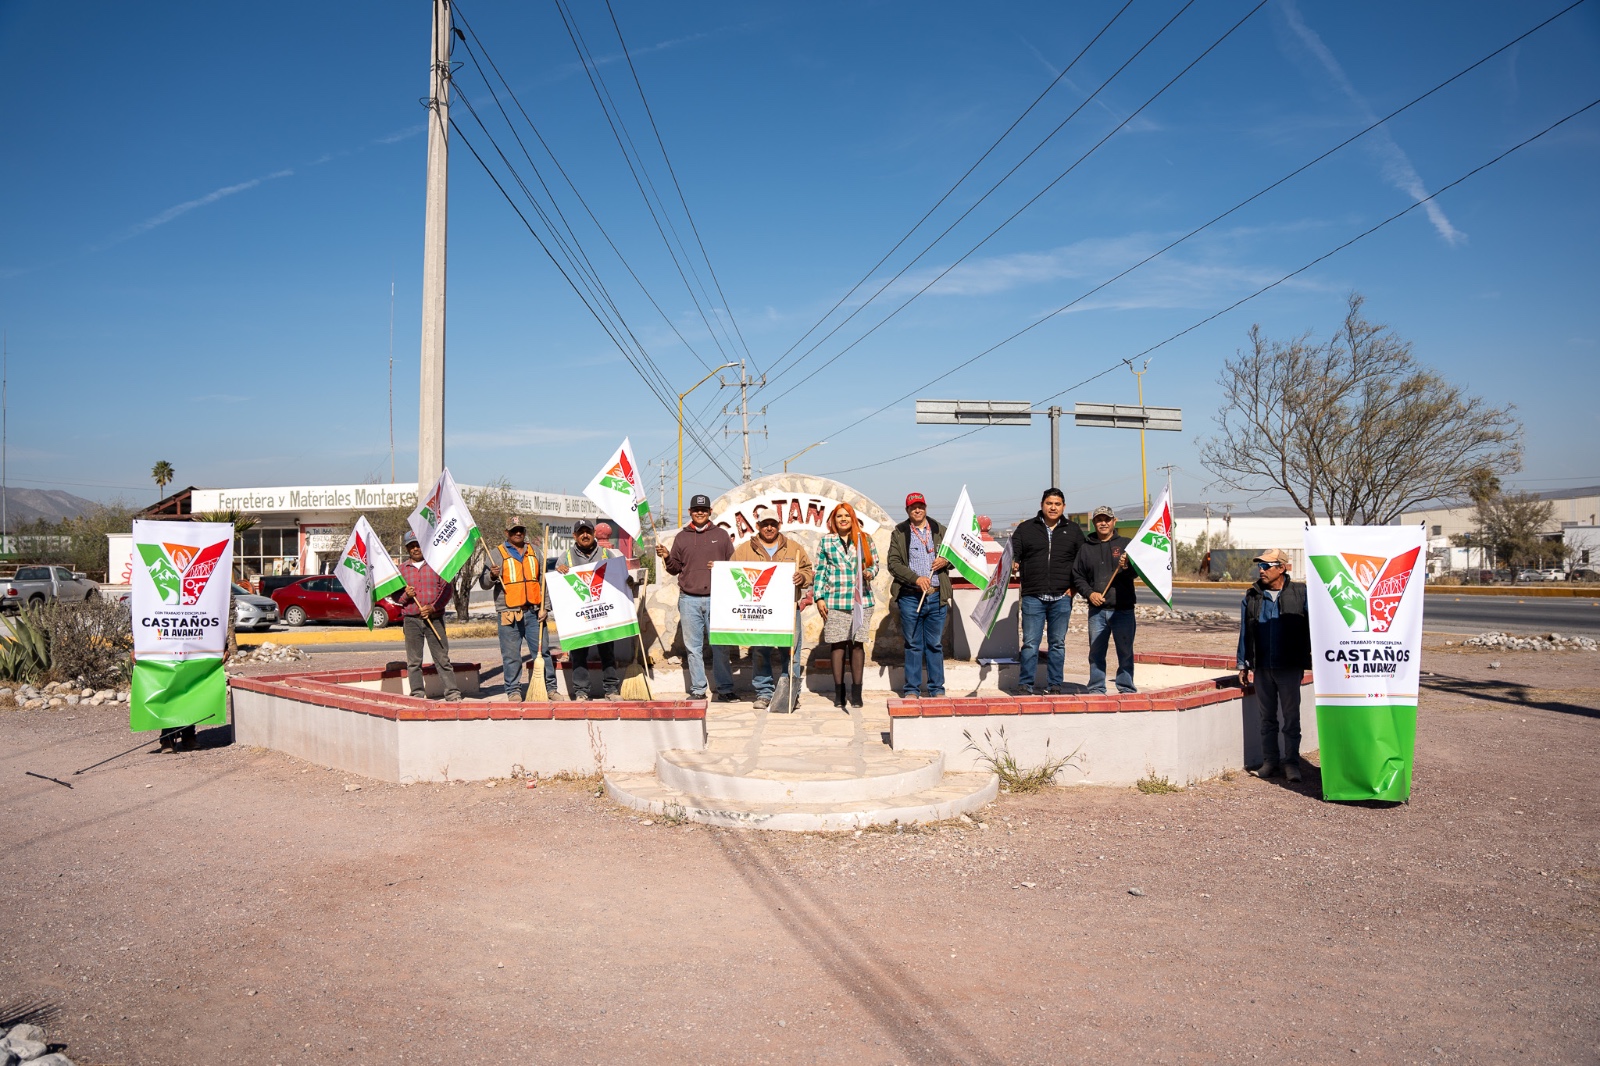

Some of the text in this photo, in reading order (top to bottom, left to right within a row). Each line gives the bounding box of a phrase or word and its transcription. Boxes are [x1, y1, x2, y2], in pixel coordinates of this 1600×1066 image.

[218, 492, 274, 508] Ferretera
[278, 495, 285, 508] y
[290, 488, 351, 508] Materiales
[534, 496, 562, 514] Monterrey
[433, 518, 457, 546] CASTAÑOS
[961, 534, 986, 556] CASTAÑOS
[576, 604, 614, 617] CASTAÑOS
[142, 615, 219, 627] CASTAÑOS
[1325, 646, 1410, 662] CASTAÑOS
[1344, 663, 1396, 673] YA AVANZA
